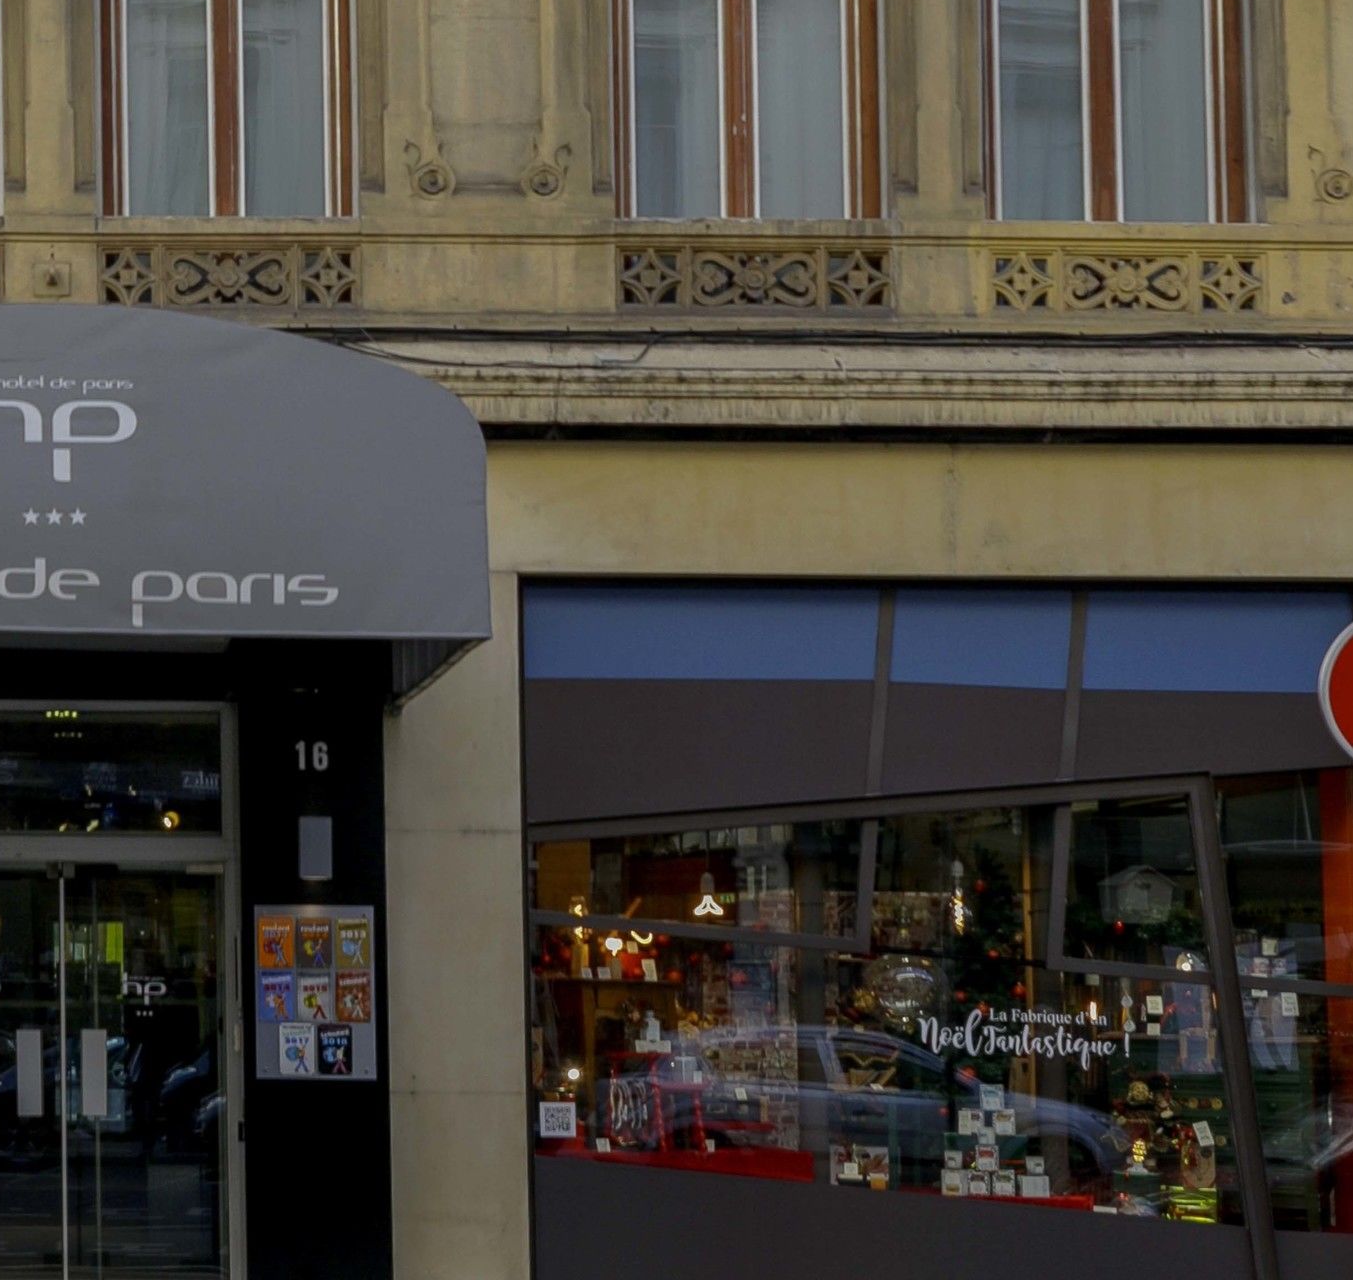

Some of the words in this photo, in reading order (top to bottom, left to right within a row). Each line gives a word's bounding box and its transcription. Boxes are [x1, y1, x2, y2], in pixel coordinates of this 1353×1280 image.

[50, 377, 77, 390] de
[82, 379, 135, 395] paris
[132, 570, 339, 627] paris
[295, 740, 329, 771] 16
[121, 972, 167, 1006] hp
[918, 1008, 983, 1057] Noël
[990, 1008, 1007, 1022] La
[1012, 1008, 1072, 1026] Fabrique
